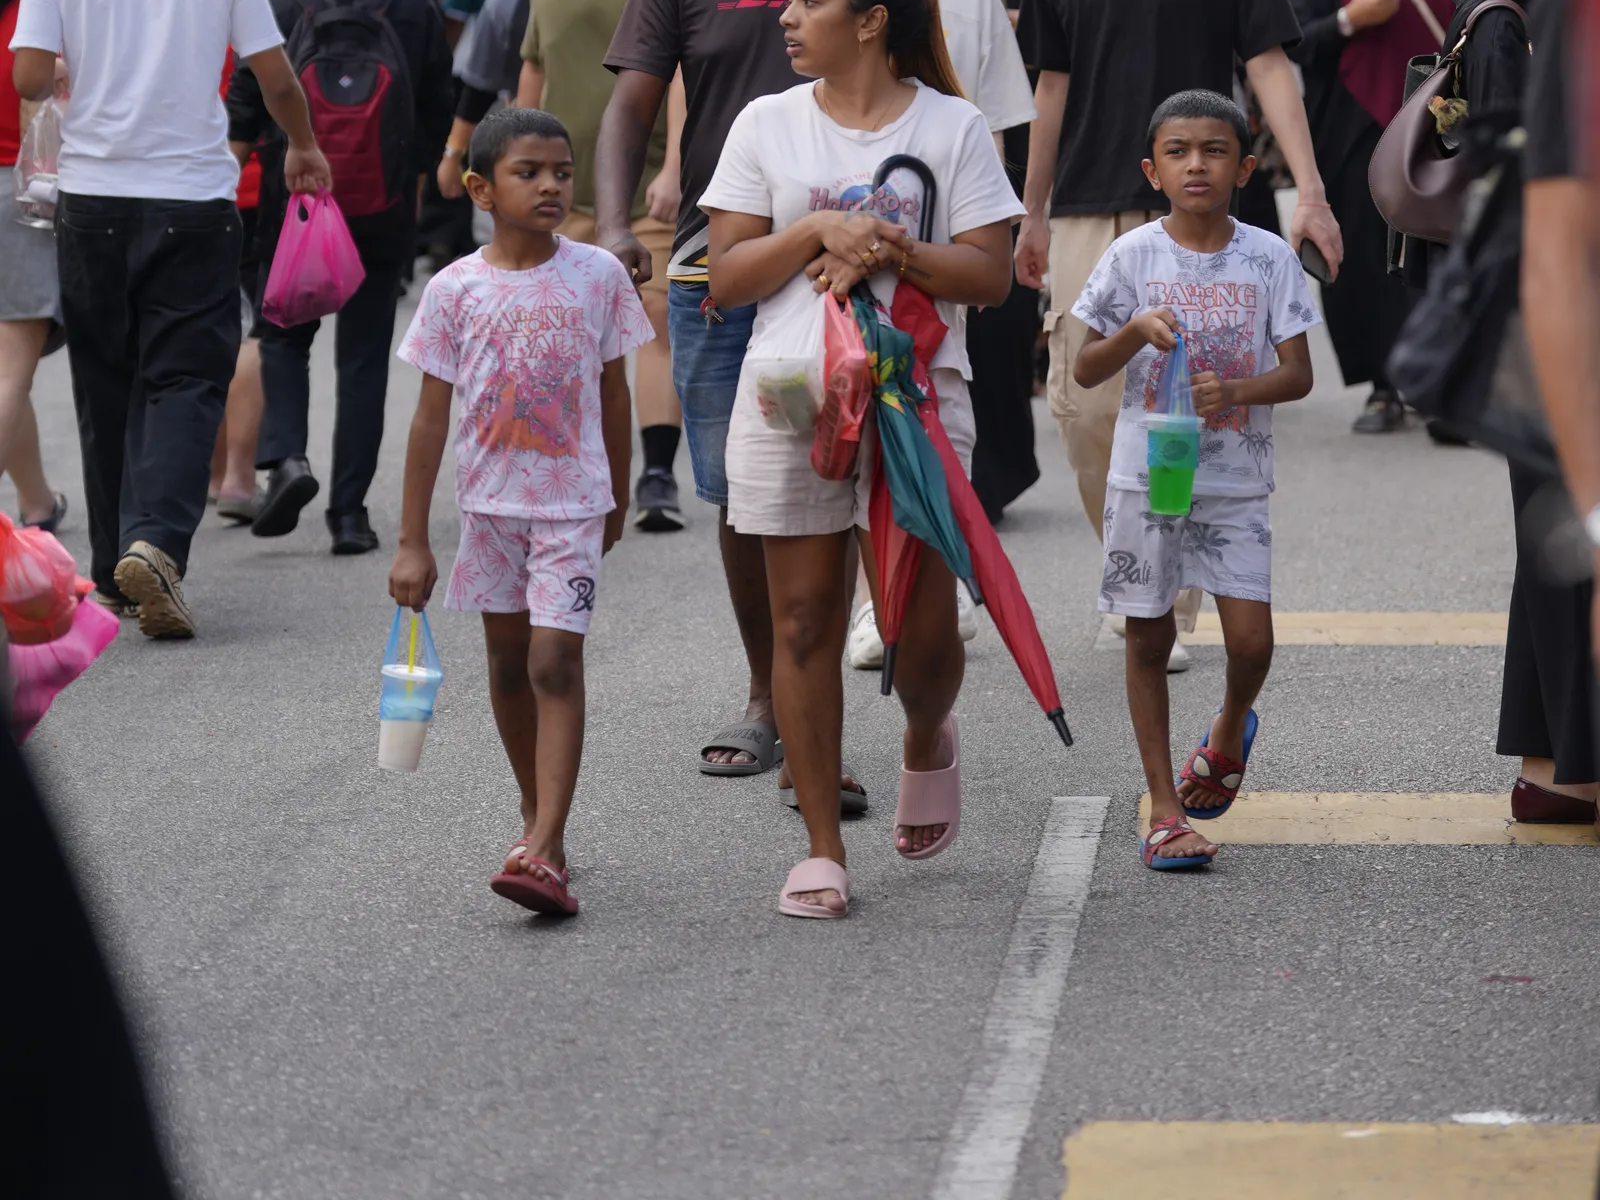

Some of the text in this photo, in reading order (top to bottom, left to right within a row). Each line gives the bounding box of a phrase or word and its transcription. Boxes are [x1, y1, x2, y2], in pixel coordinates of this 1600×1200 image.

[867, 186, 921, 223] Rock
[1182, 308, 1256, 335] BALI
[508, 333, 583, 360] BALI
[1105, 550, 1152, 586] Bali
